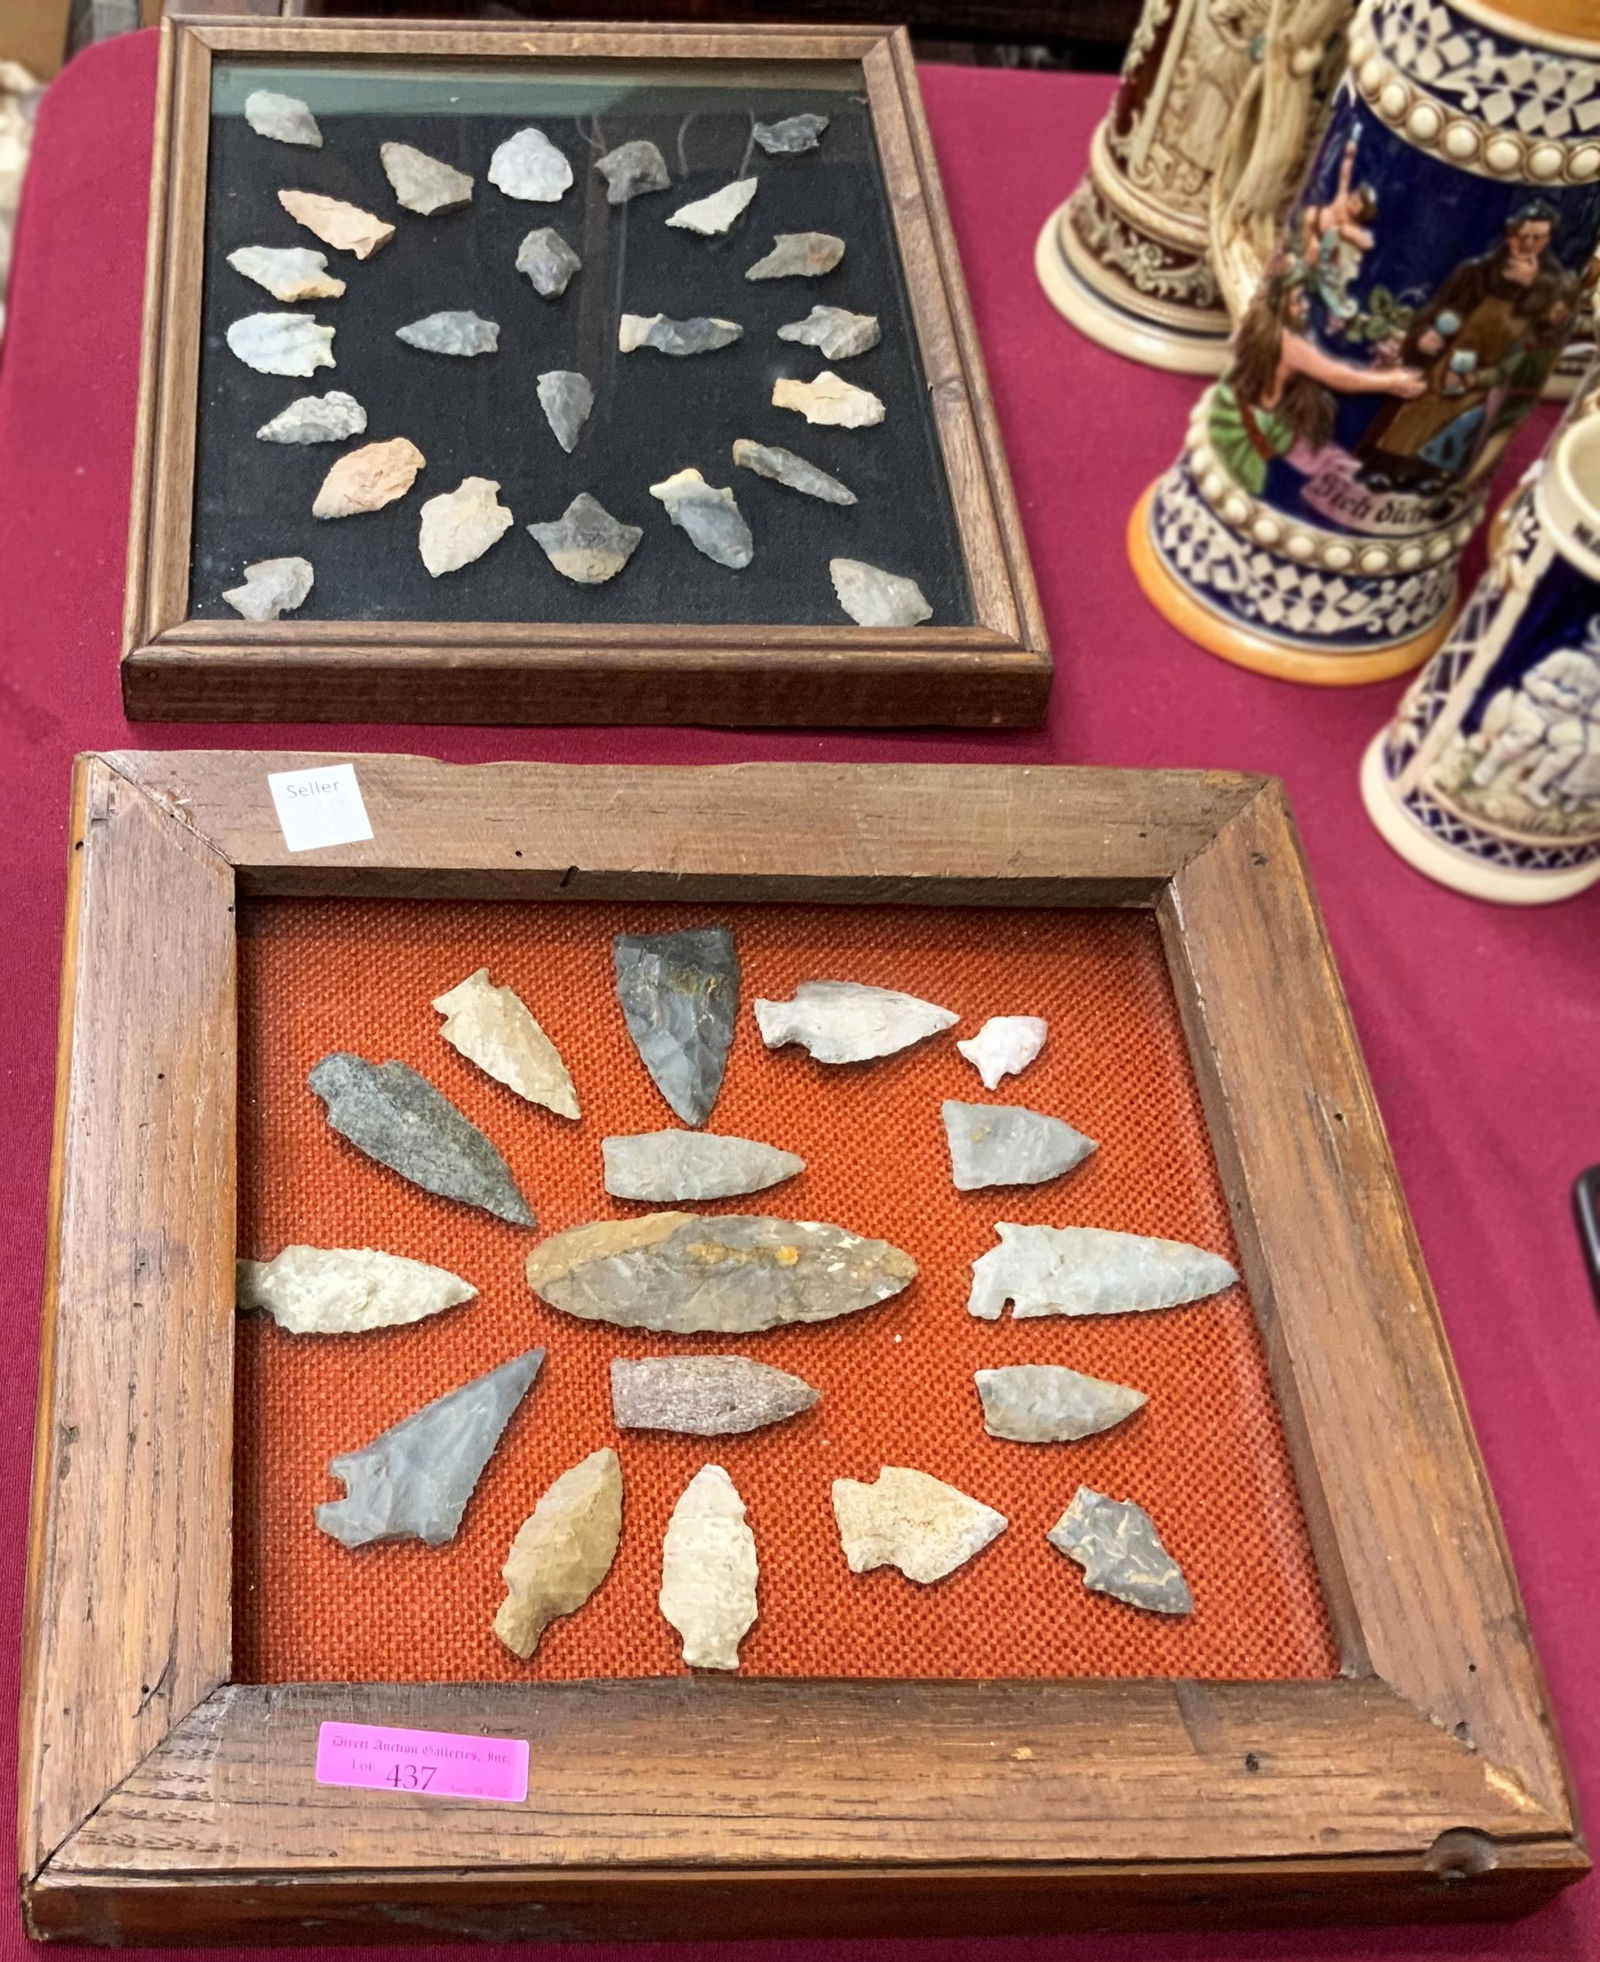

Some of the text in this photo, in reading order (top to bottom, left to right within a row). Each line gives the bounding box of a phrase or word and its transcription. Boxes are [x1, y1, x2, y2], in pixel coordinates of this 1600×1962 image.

[286, 780, 340, 799] Seller
[332, 1735, 369, 1750] Direct
[373, 1740, 418, 1755] Auction
[422, 1746, 481, 1762] Galleries,
[352, 1759, 438, 1790] Lot 437
